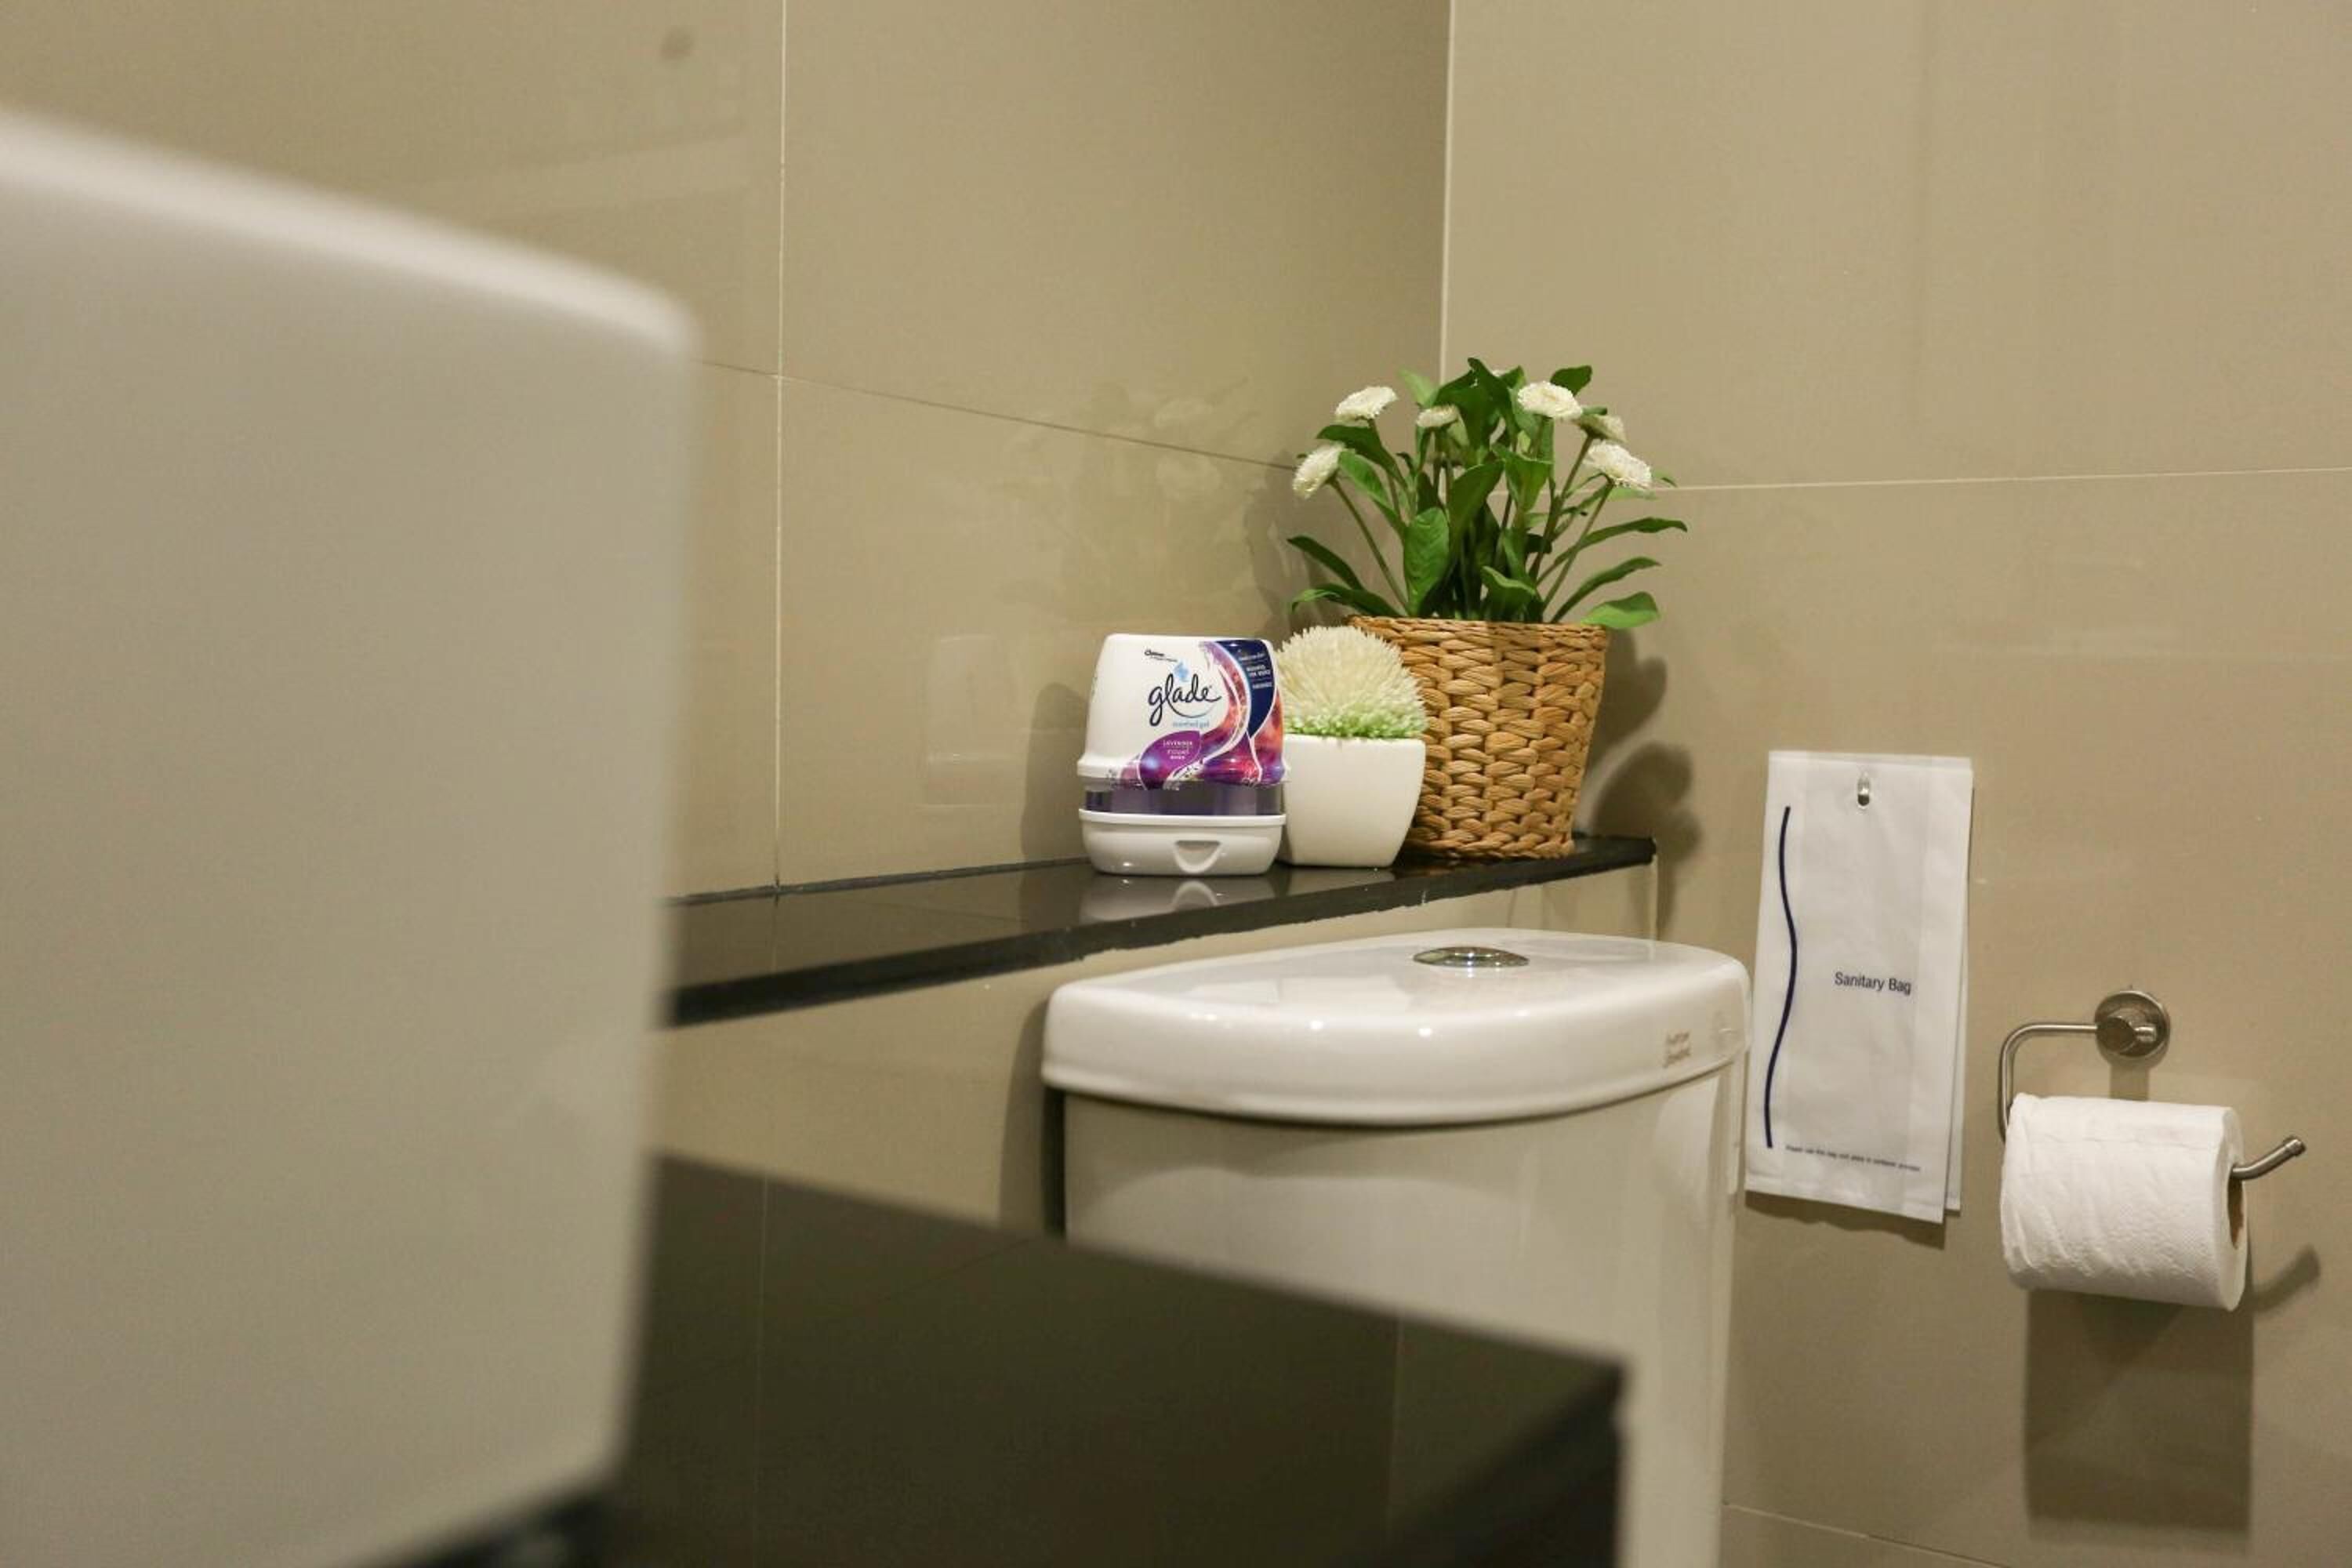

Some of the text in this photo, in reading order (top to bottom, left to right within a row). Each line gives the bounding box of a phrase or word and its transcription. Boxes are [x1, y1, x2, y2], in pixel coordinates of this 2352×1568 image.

[1148, 673, 1222, 726] glade
[1835, 971, 1911, 996] Sanitary Bag
